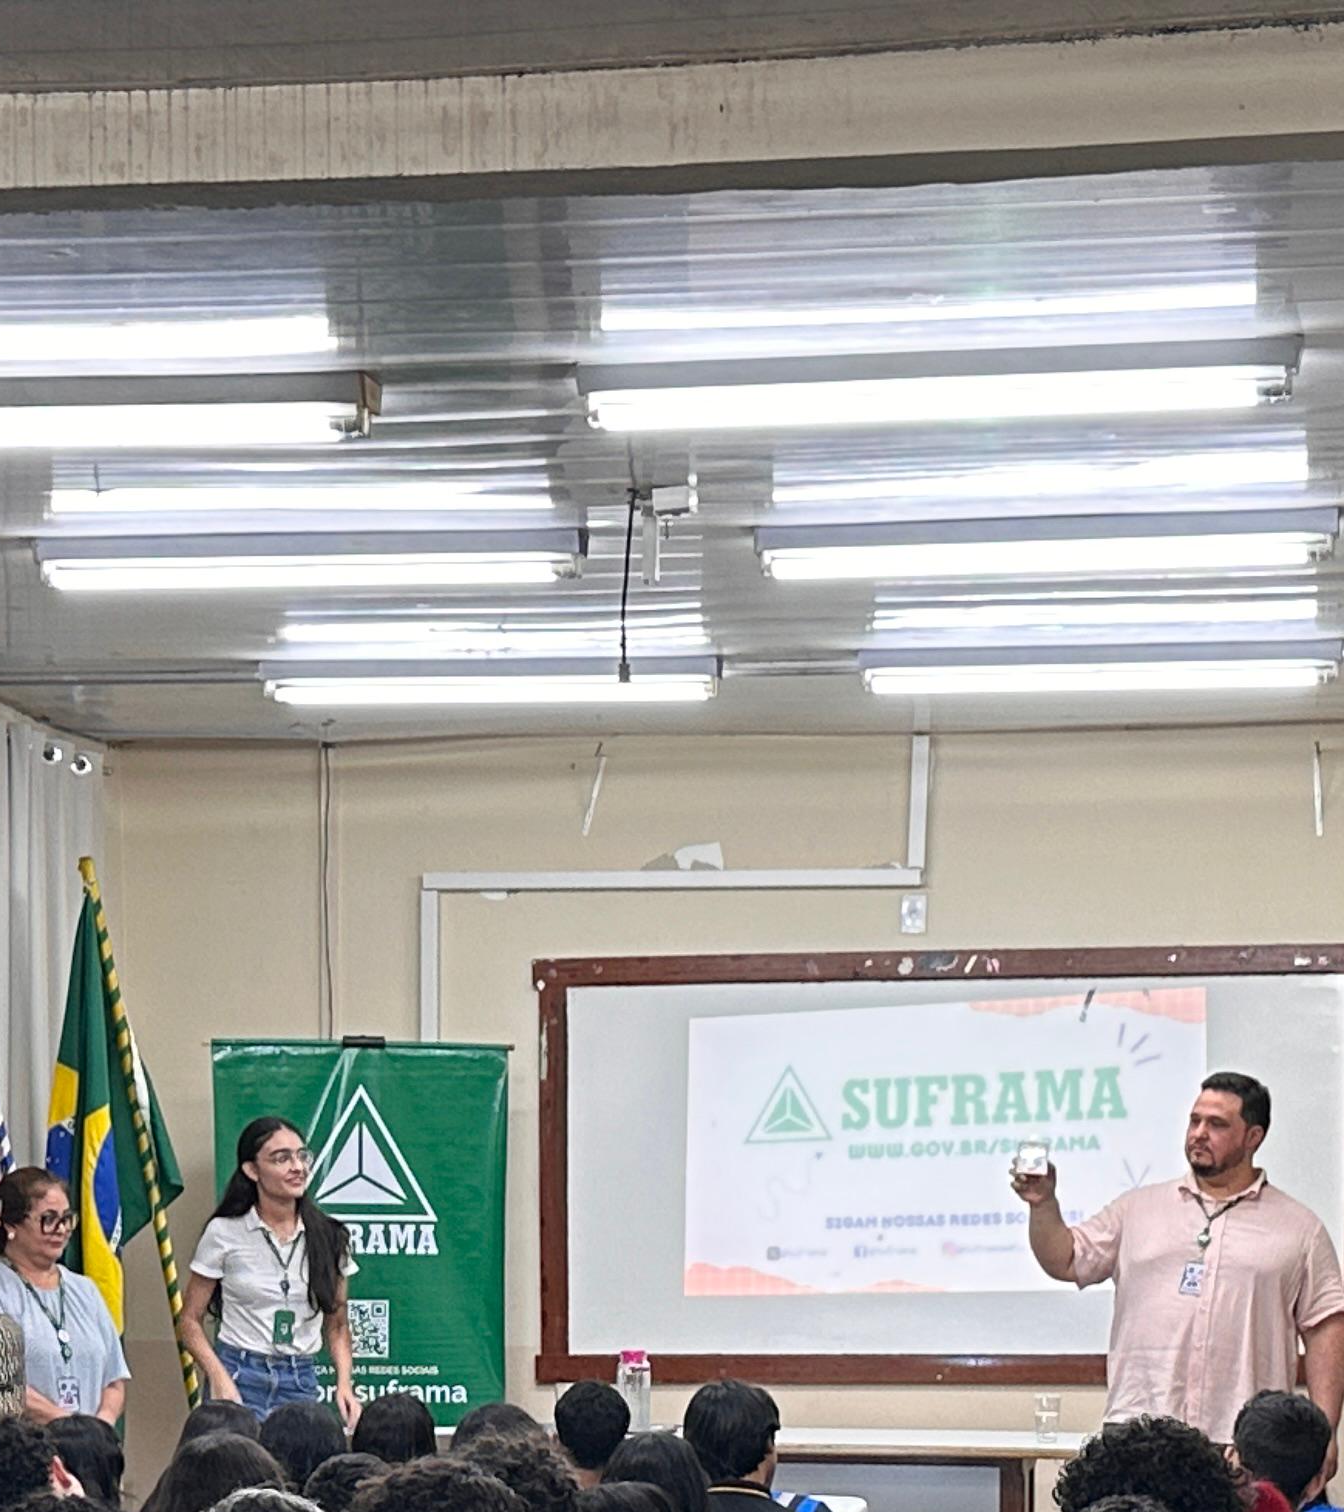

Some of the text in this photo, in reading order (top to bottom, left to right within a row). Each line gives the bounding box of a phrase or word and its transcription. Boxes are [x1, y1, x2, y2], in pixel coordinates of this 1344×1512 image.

[841, 1066, 1128, 1131] SUFRAMA
[825, 1216, 878, 1230] SIGAM
[881, 1214, 945, 1228] NOSSAS
[950, 1212, 1002, 1226] REDES
[343, 1222, 439, 1255] RAMA
